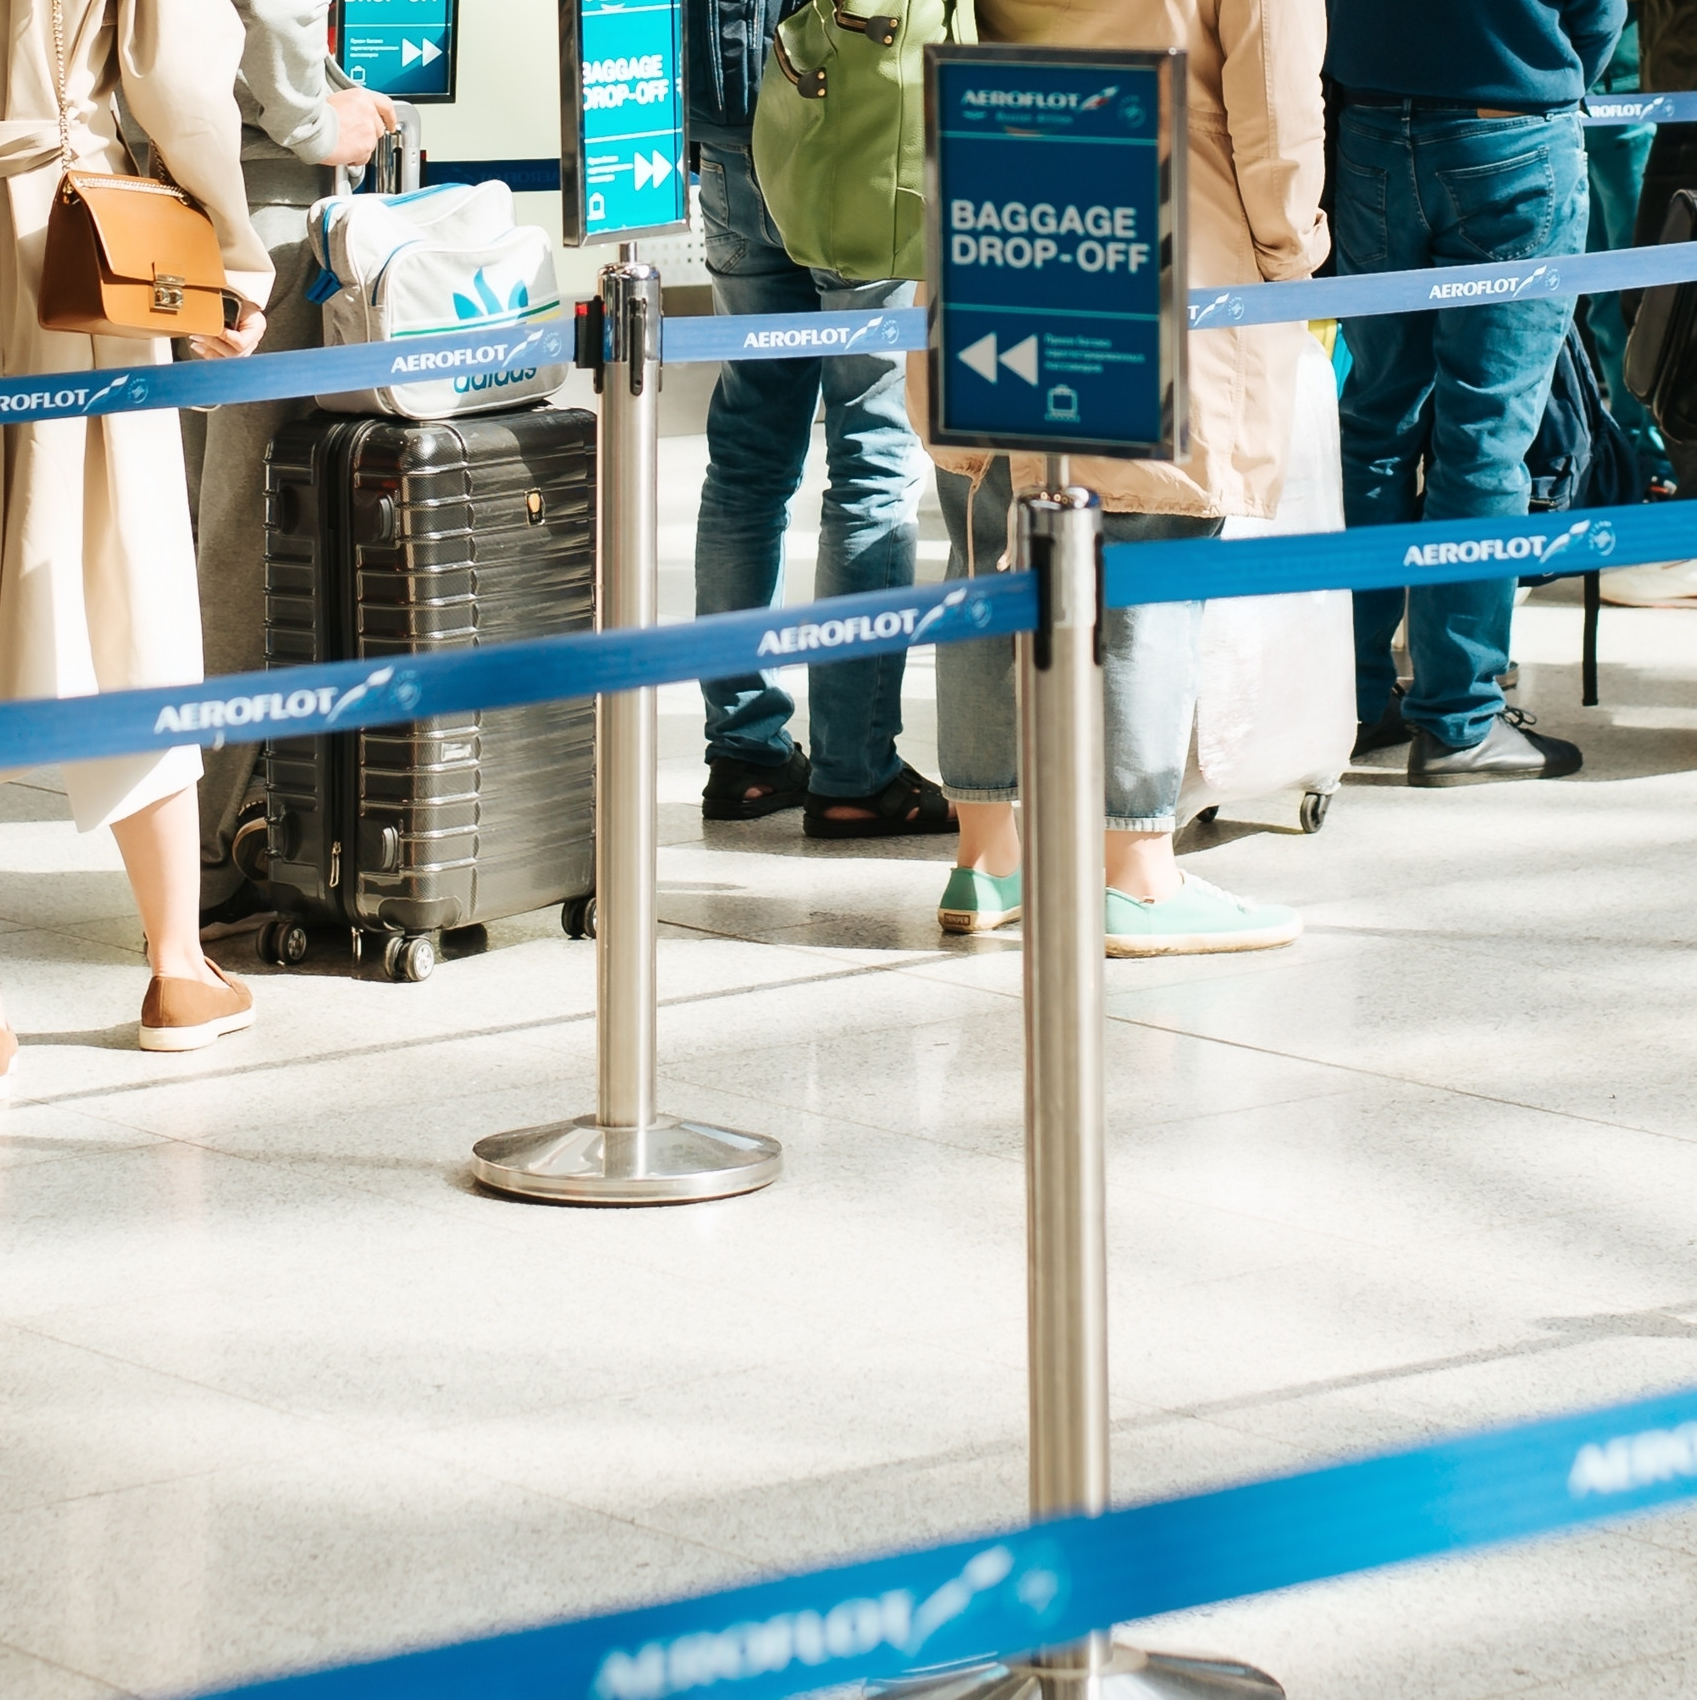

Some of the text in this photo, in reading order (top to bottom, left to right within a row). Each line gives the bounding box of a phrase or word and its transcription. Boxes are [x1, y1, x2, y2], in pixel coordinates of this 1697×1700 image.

[962, 89, 1082, 110] AEROFLOT
[1588, 103, 1643, 119] ROFLOT
[950, 199, 1138, 240] BAGGAGE
[951, 234, 1151, 273] DROP-OFF
[1428, 276, 1520, 301] AEROFLOT
[743, 327, 850, 348] AEROFLOT
[390, 344, 508, 374] AEROFLOT
[1403, 535, 1547, 567] AEROFLOT
[757, 608, 919, 657] AEROFLOT
[153, 686, 338, 734] AEROFLOT
